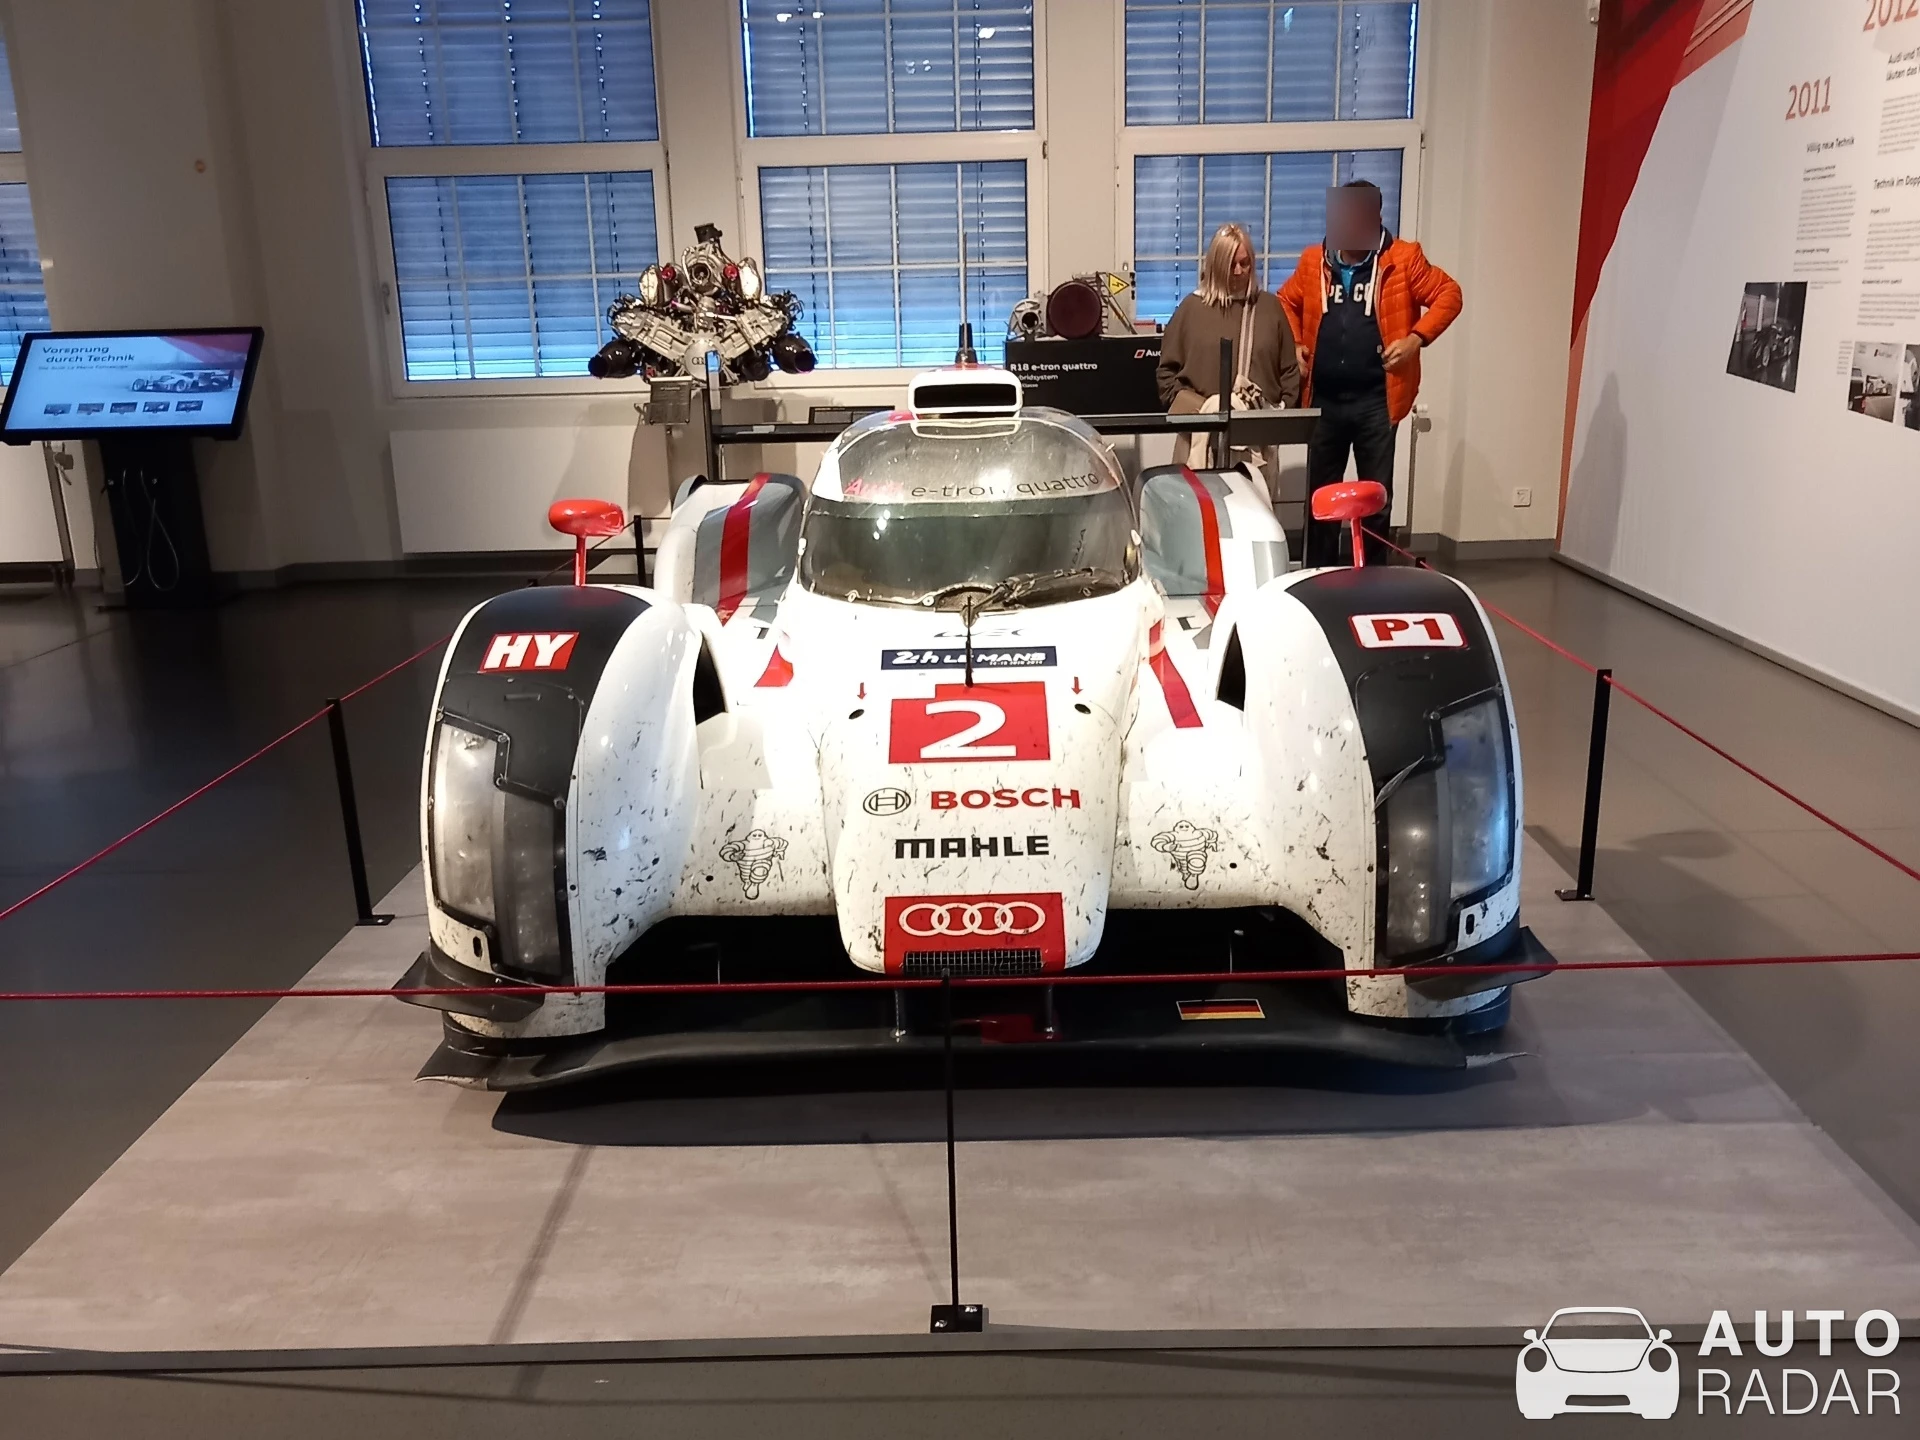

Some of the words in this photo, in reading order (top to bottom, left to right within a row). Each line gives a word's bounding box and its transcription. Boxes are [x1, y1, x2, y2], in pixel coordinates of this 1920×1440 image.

[1785, 75, 1832, 121] 2011
[42, 346, 110, 355] Vorsprung
[46, 355, 83, 363] durch
[87, 354, 135, 362] Technik
[1010, 363, 1030, 372] R18
[1031, 363, 1061, 371] e-tron
[1062, 362, 1098, 372] quattro
[1018, 373, 1059, 382] bridsystem
[1016, 471, 1099, 496] quattro
[1371, 618, 1445, 642] P1
[483, 633, 575, 670] HY
[976, 652, 1046, 663] MANS
[920, 699, 1017, 759] 2
[930, 787, 1081, 810] BOSCH
[895, 834, 1050, 860] MAHLE
